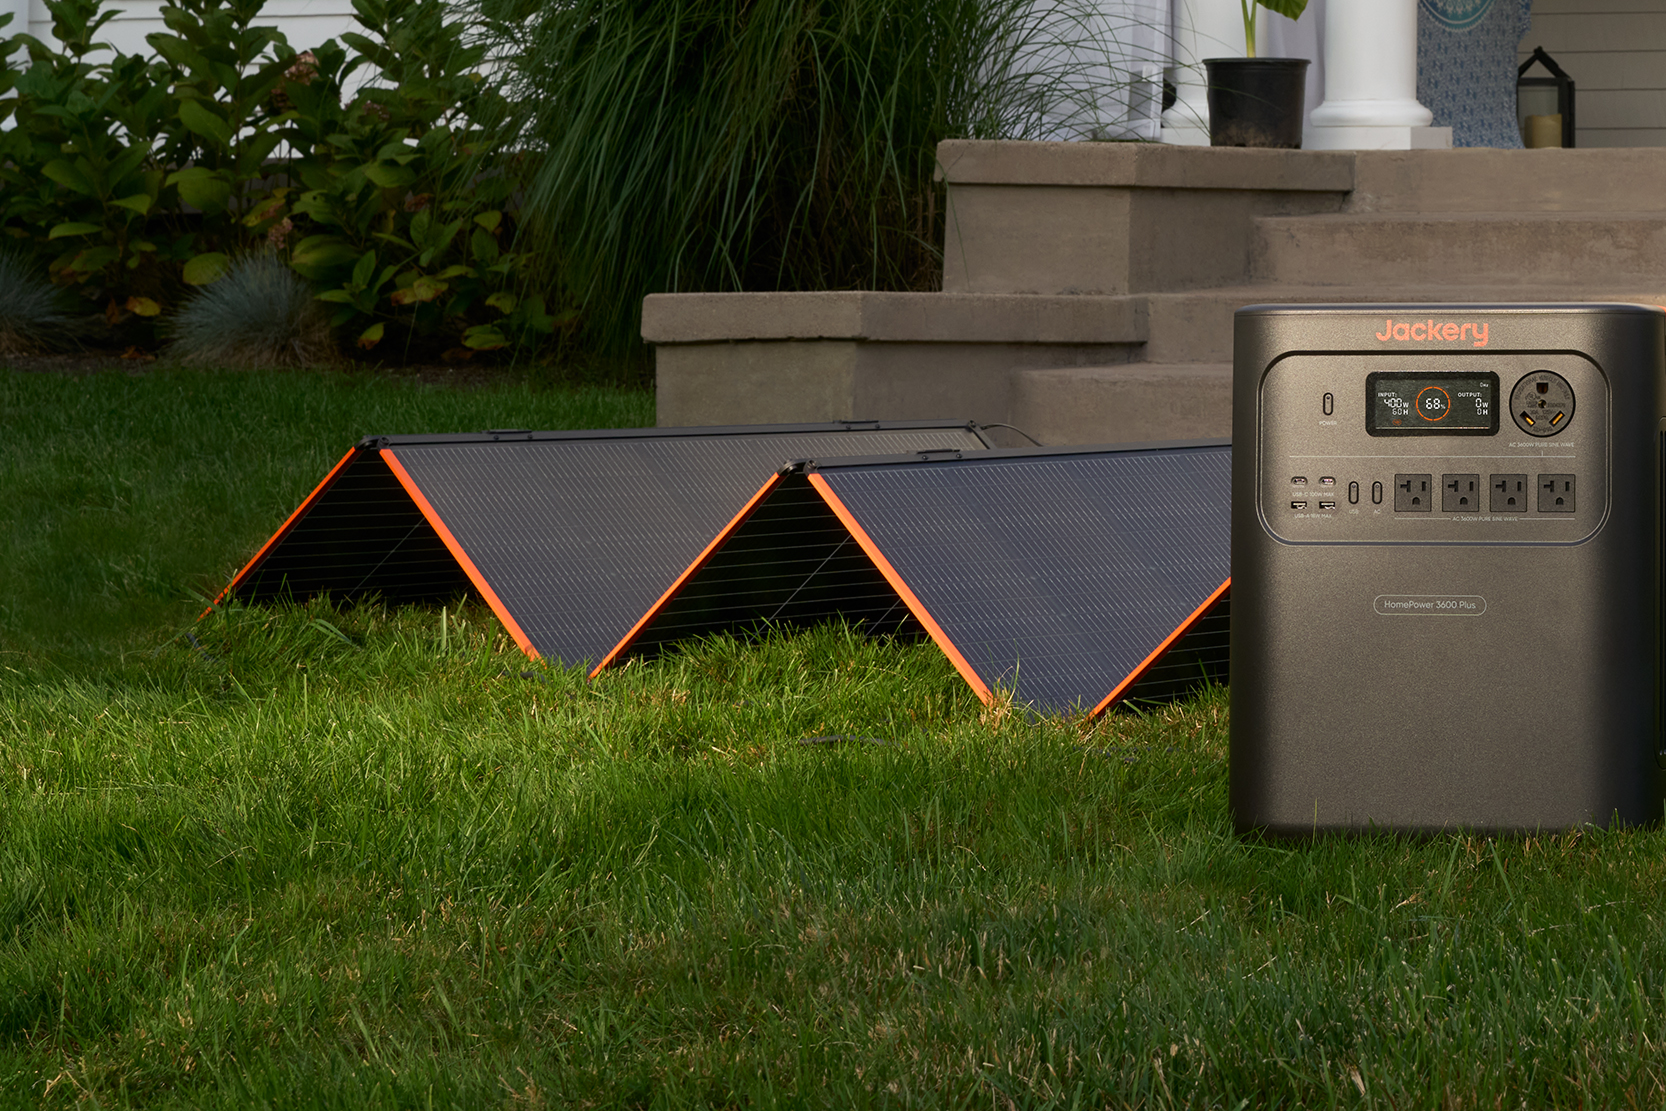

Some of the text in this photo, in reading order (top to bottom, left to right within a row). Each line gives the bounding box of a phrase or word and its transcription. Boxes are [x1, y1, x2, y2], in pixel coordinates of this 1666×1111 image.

[1376, 319, 1489, 348] Jackery
[1384, 600, 1477, 609] HomePower 3600 Plus
